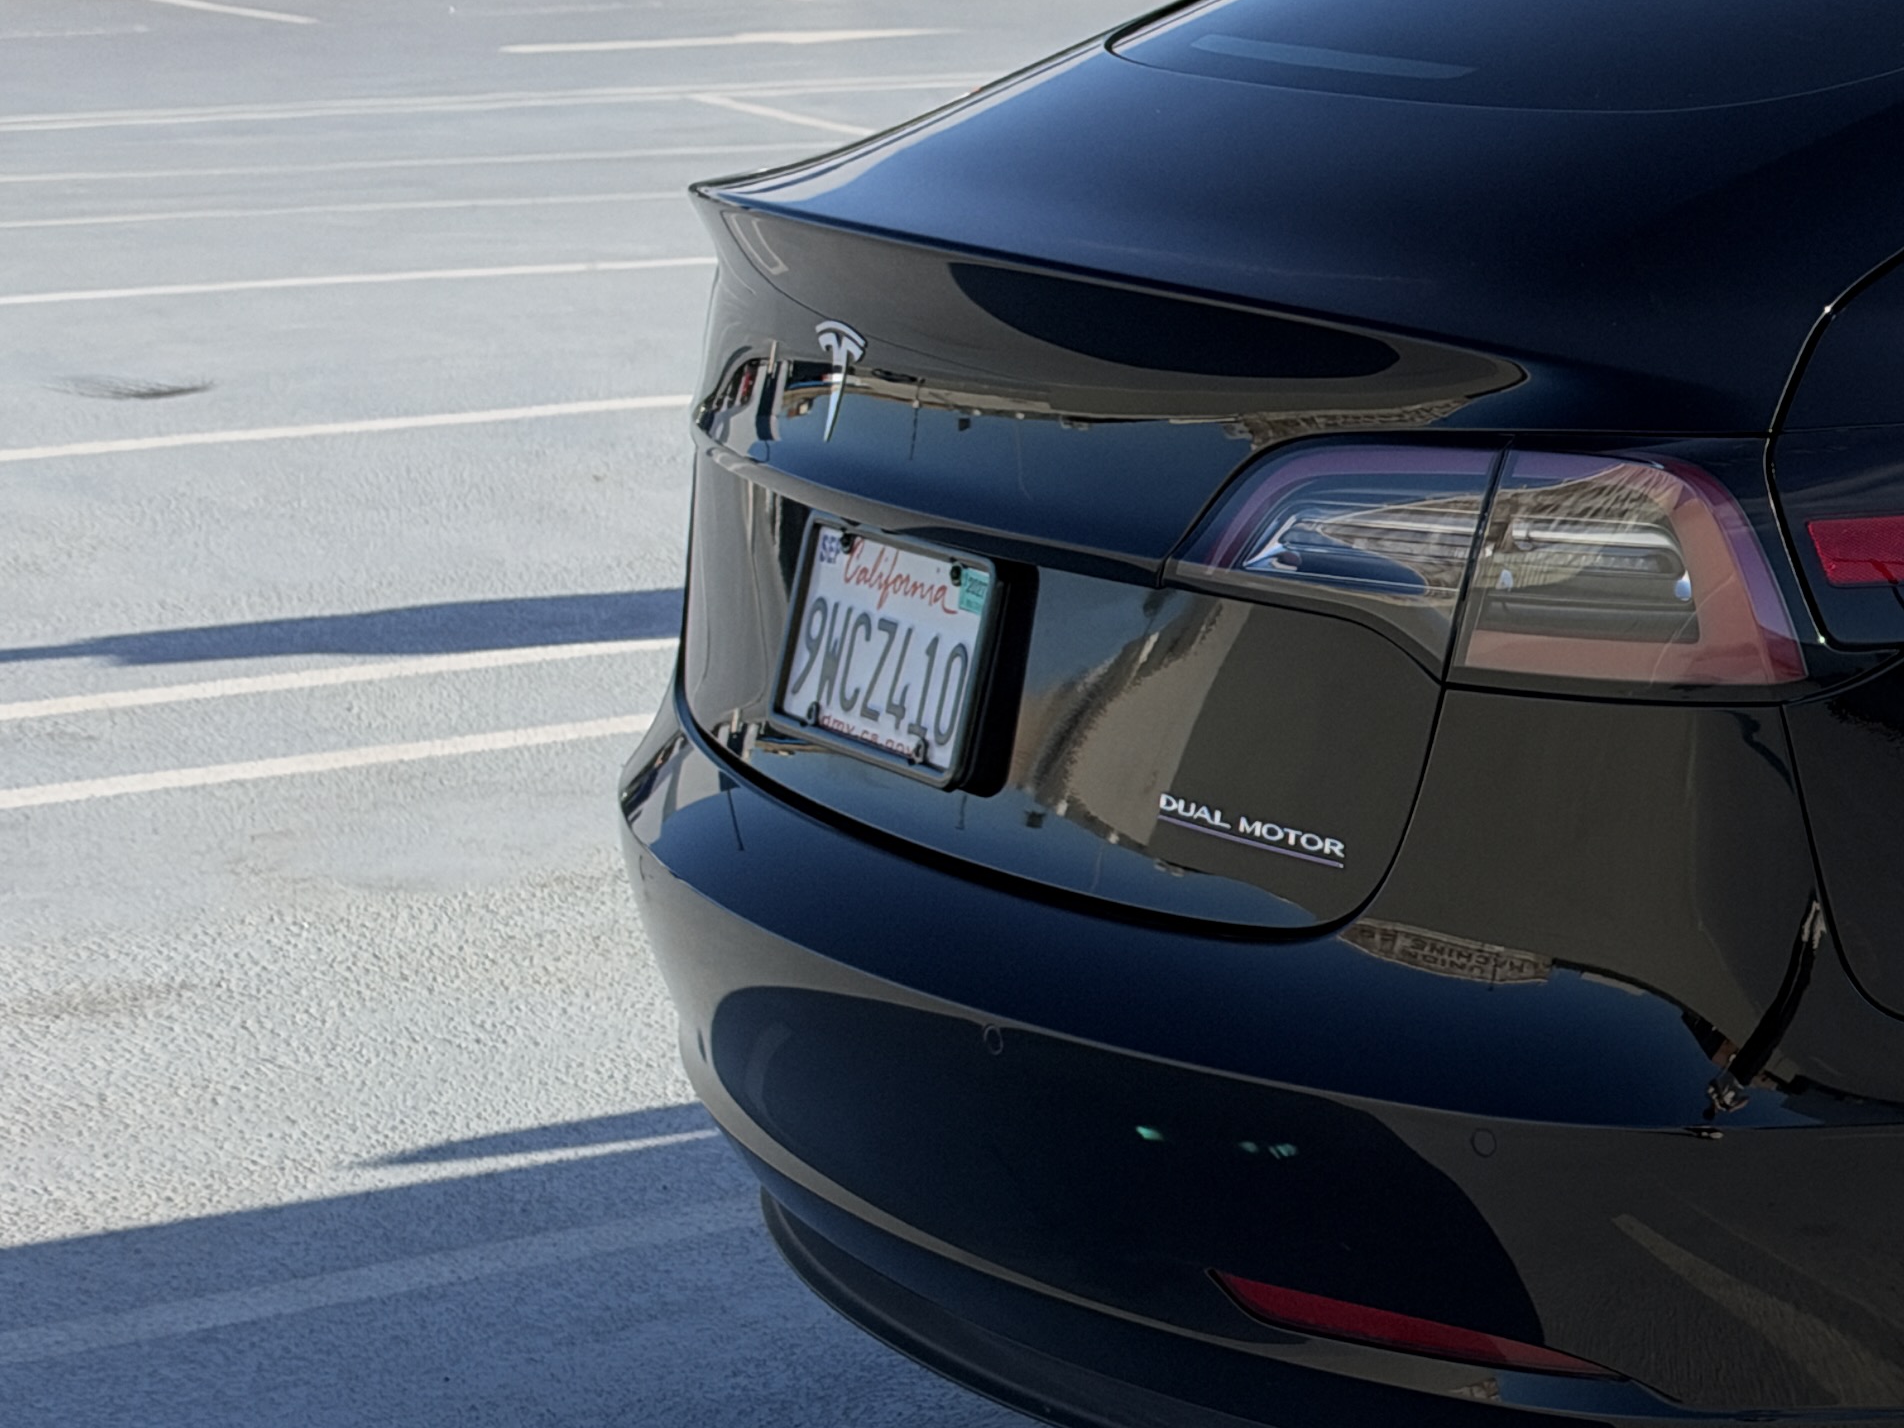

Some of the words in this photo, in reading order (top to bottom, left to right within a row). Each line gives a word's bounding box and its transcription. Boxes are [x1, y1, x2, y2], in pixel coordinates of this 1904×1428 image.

[843, 535, 959, 615] California
[791, 596, 969, 747] 9WCZ410
[1159, 793, 1232, 830] DUAL
[1238, 816, 1345, 858] MOTOR
